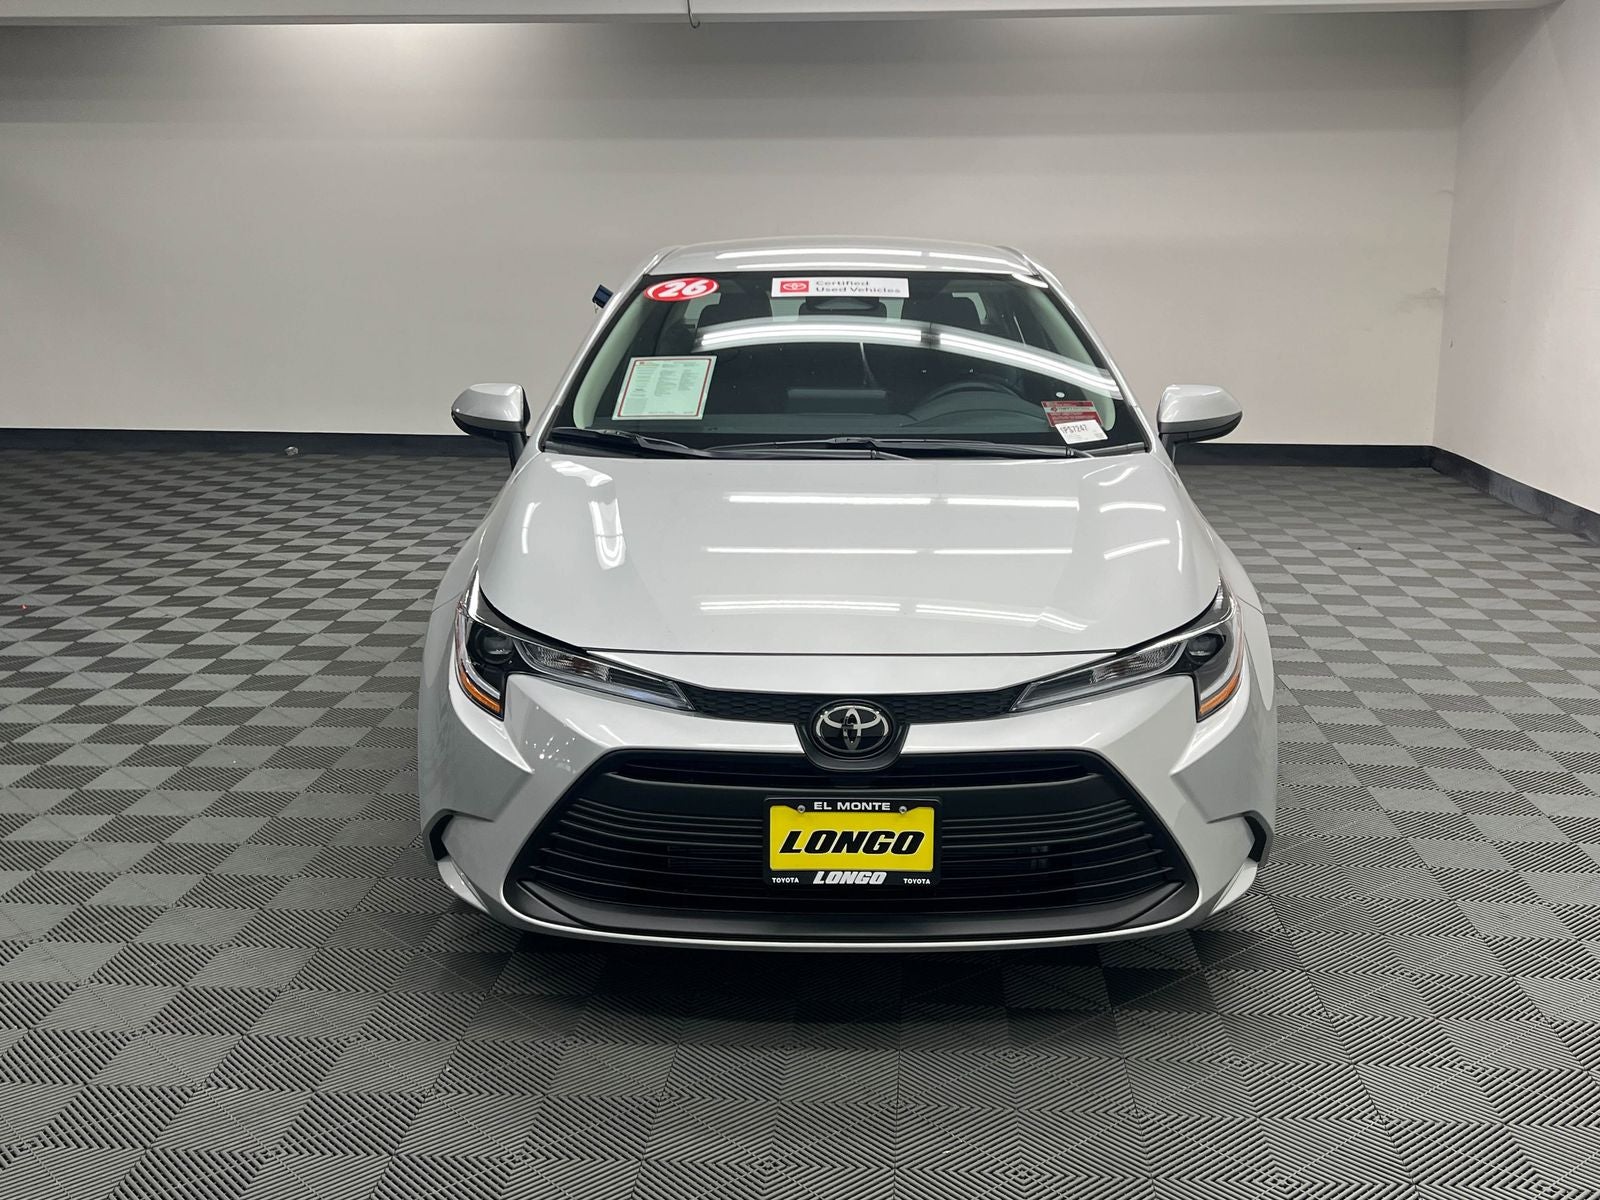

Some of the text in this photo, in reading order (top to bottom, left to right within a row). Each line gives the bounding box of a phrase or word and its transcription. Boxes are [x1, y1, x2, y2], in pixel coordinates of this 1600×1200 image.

[657, 280, 709, 297] 26
[813, 802, 891, 811] EL MONTE
[779, 830, 925, 855] LONGO
[812, 871, 887, 885] LONGO
